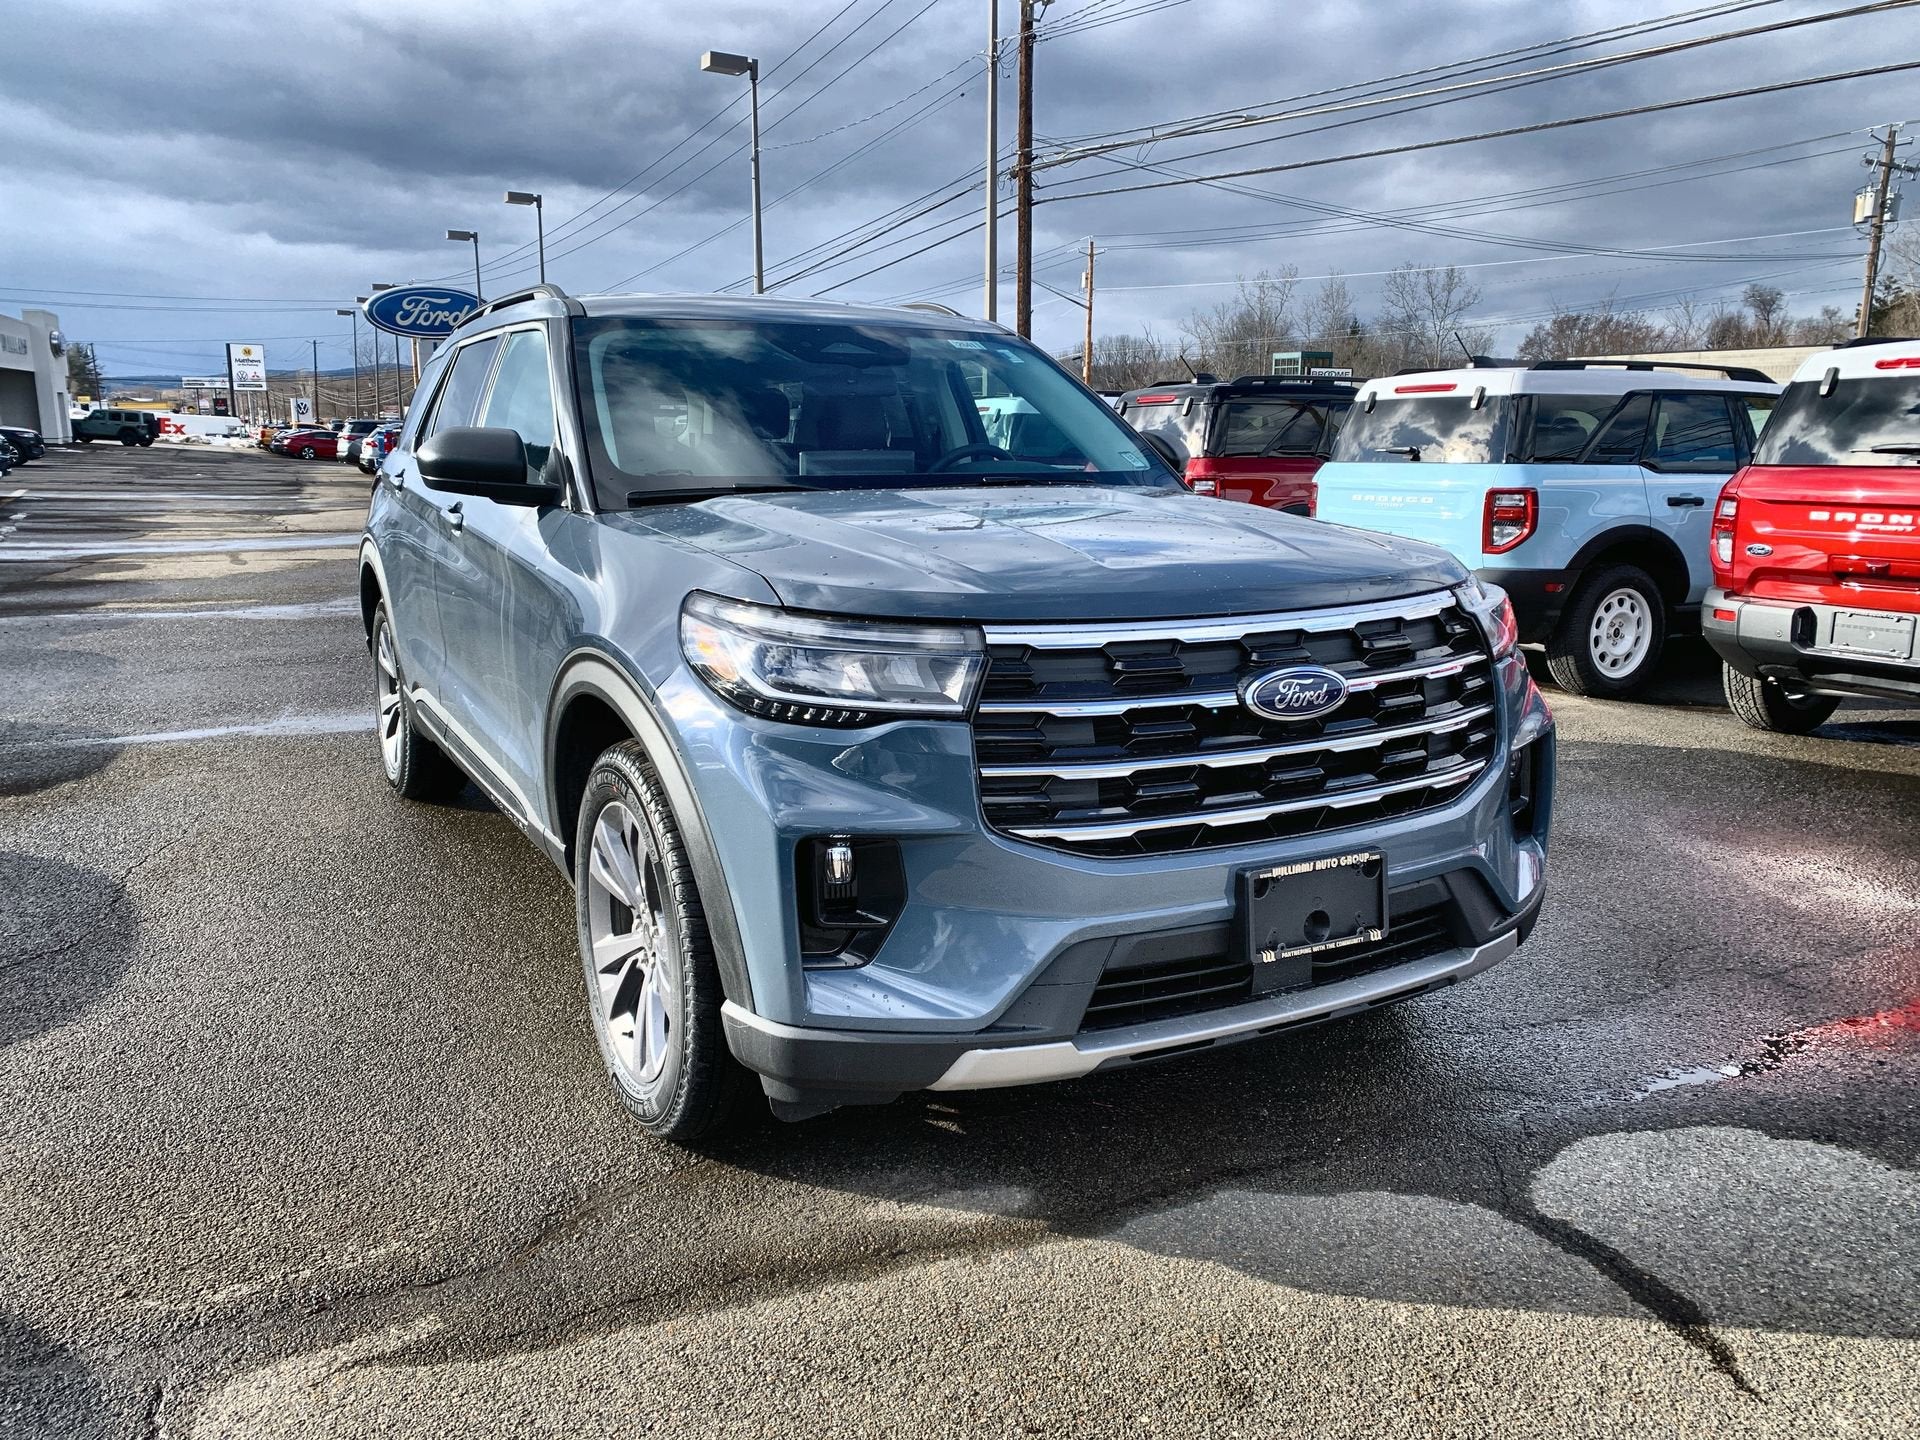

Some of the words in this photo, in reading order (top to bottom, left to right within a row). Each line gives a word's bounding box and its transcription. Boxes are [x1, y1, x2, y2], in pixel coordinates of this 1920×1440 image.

[395, 295, 471, 327] Ford
[1352, 494, 1434, 504] BRONCO
[1809, 511, 1920, 524] BRON
[1856, 523, 1917, 532] SPORT
[1275, 678, 1329, 709] Ford
[597, 772, 628, 796] MICHELIN
[1315, 858, 1338, 870] AUTO
[1281, 947, 1312, 958] PARTNERING
[1312, 944, 1326, 953] WITH
[1326, 942, 1336, 951] THE
[1336, 937, 1365, 948] COMMUNITY
